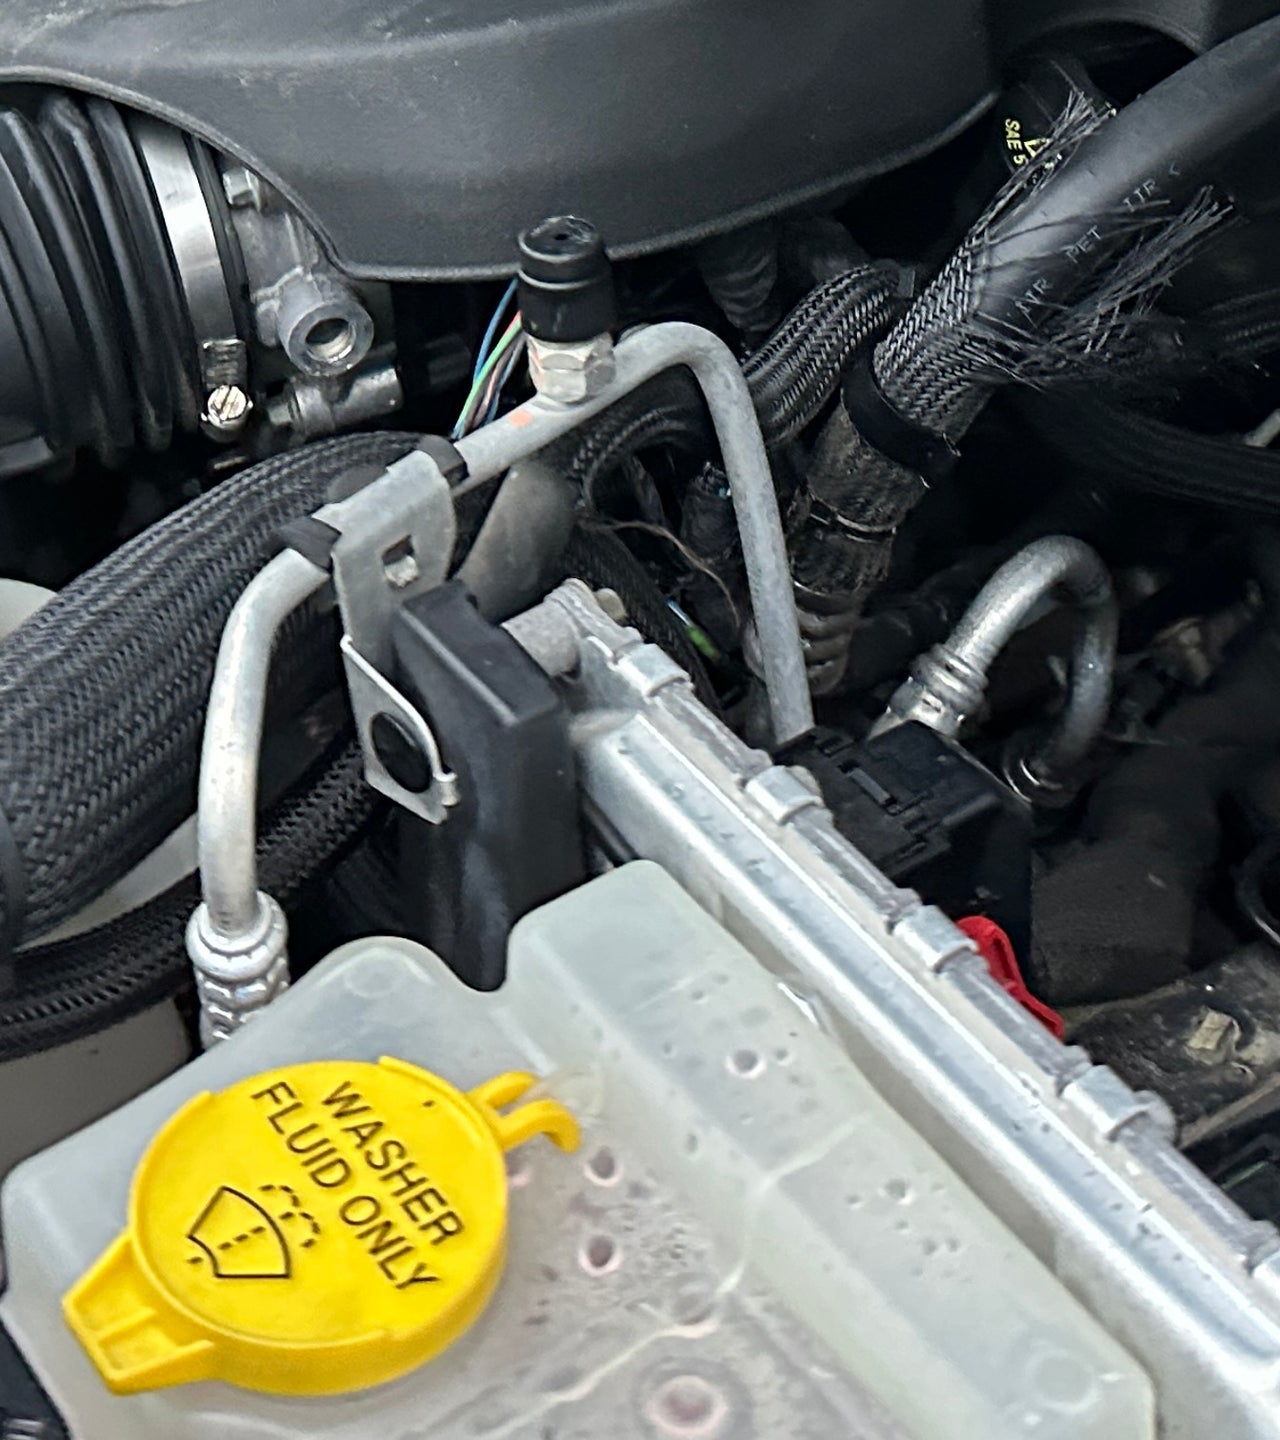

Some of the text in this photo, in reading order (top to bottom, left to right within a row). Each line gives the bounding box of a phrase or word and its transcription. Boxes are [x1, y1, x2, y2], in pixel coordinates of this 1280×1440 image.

[1004, 118, 1023, 151] SAE
[250, 1080, 440, 1290] FLUID ONLY
[321, 1080, 465, 1246] WASHER
